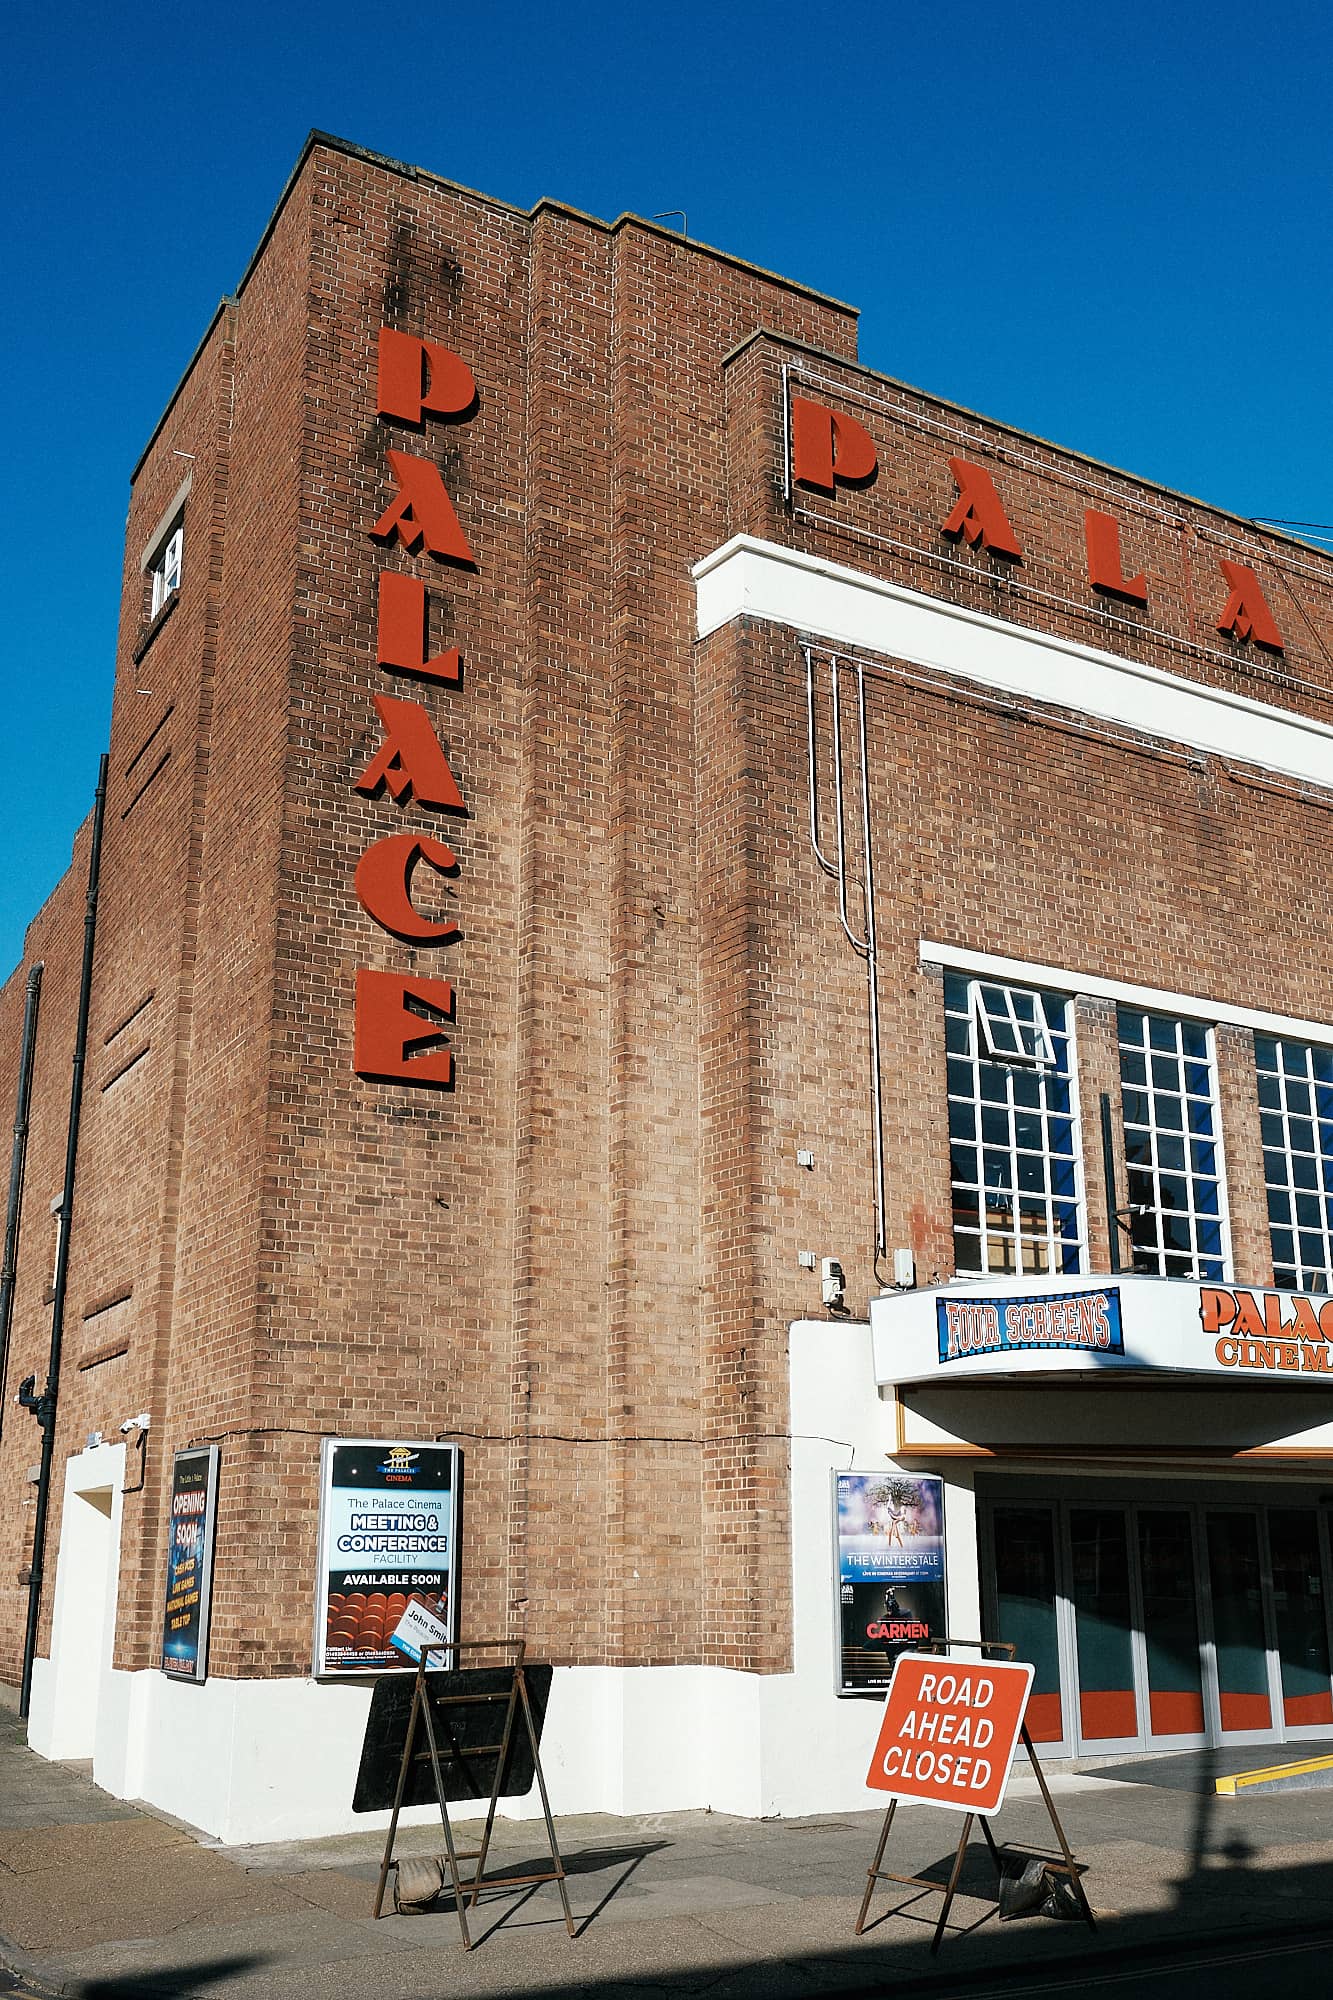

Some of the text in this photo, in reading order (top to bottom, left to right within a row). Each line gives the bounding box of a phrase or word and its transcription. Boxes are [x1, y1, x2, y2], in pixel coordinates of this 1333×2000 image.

[354, 326, 478, 1084] PALACE
[946, 1295, 1110, 1356] FOUR SCREENS
[1215, 1337, 1333, 1373] CINEM
[385, 1474, 412, 1482] CINEMA
[173, 1490, 206, 1515] OPENING
[347, 1498, 442, 1510] The Palace Cinema
[351, 1514, 439, 1531] MEETING &
[176, 1523, 198, 1544] SOON
[337, 1535, 447, 1552] CONFERENCE
[373, 1554, 418, 1564] FACILITY
[846, 1555, 939, 1566] THE WINTER'S TALE
[343, 1574, 441, 1586] AVAILABLE SOON
[408, 1610, 429, 1629] John
[866, 1623, 929, 1639] CARMEN
[917, 1673, 994, 1709] ROAD
[898, 1710, 994, 1749] AHEAD
[883, 1746, 992, 1790] CLOSED
